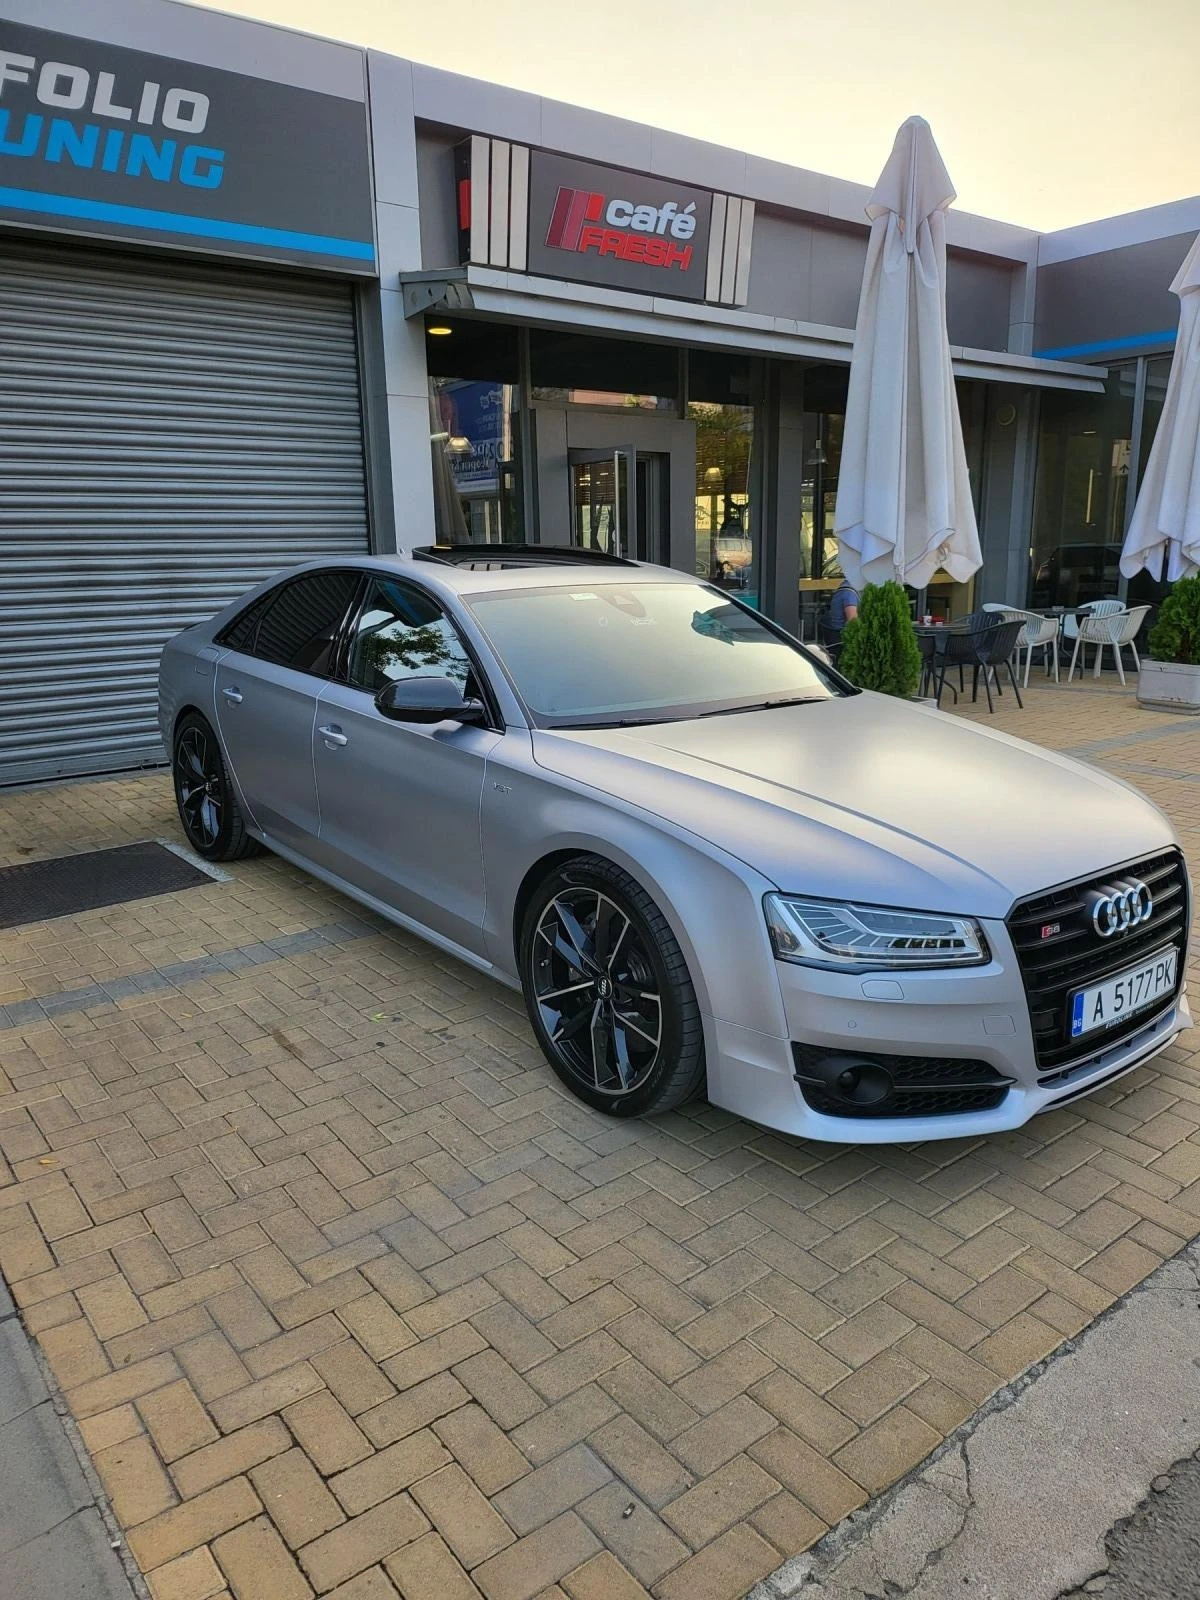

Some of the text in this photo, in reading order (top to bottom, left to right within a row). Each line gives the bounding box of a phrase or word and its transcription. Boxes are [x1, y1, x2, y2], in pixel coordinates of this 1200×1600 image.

[0, 50, 210, 134] FOLIO
[0, 108, 225, 189] UNING
[605, 200, 697, 240] café
[579, 226, 693, 271] FRESH
[1073, 1018, 1082, 1029] BG
[1093, 991, 1103, 1022] A
